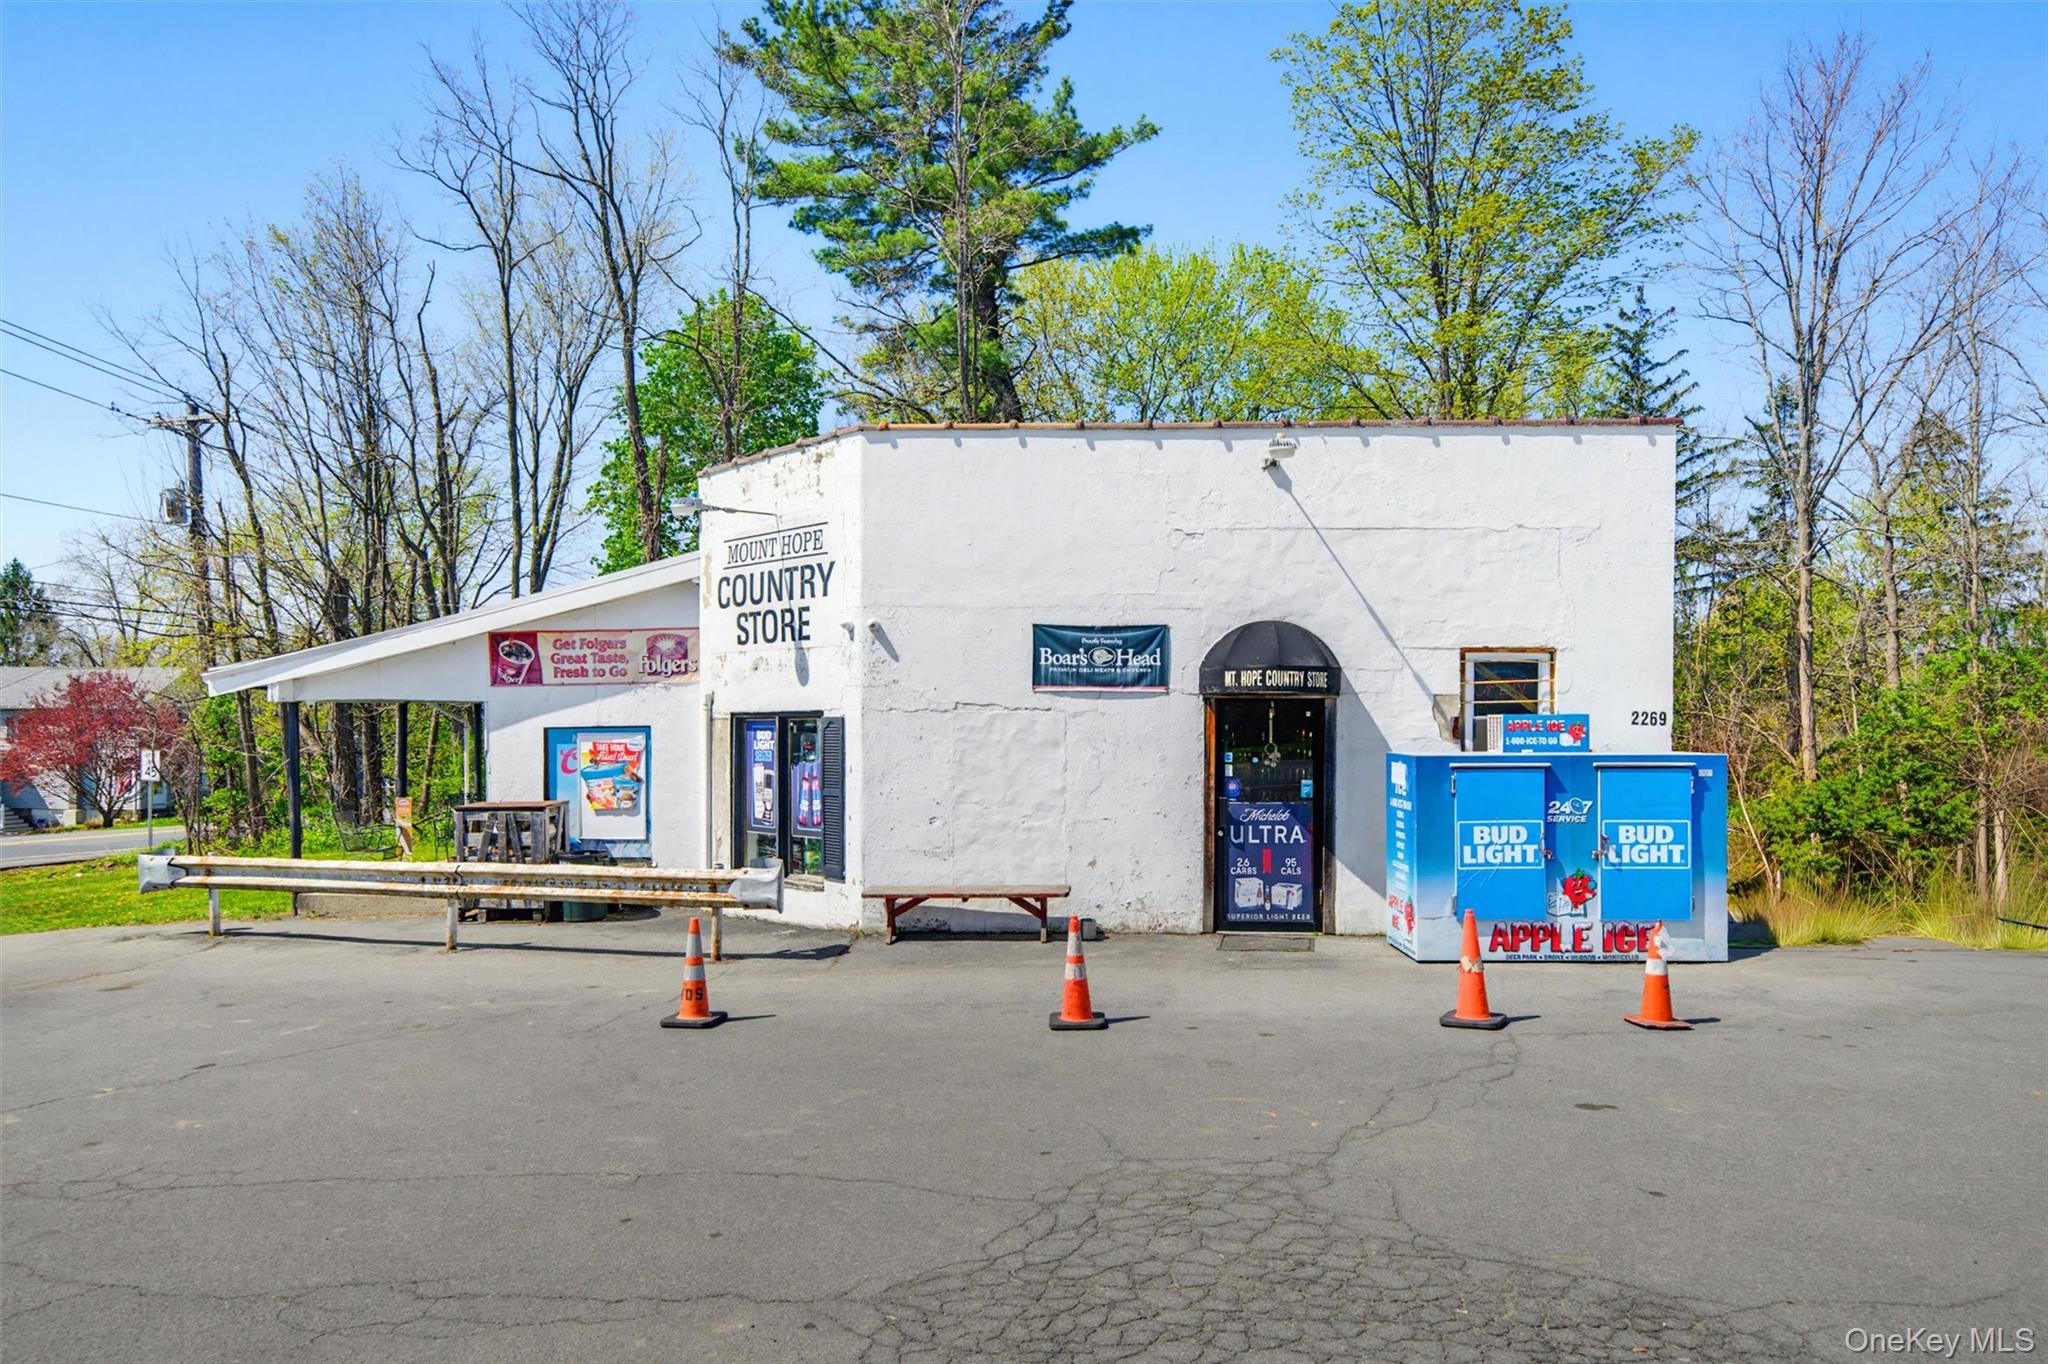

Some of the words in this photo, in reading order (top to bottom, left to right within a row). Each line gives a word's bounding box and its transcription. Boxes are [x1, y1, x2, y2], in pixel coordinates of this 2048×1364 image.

[727, 537, 778, 565] MOUNT
[781, 529, 824, 556] HOPE
[718, 560, 836, 609] COUNTRY
[736, 606, 811, 646] STORE
[552, 638, 576, 651] Get
[579, 637, 627, 652] Folgers
[550, 653, 588, 665] Great
[1039, 647, 1088, 665] Boar's
[1116, 648, 1161, 666] Head
[553, 666, 589, 679] Fresh
[592, 666, 606, 678] to
[609, 666, 629, 678] Go
[1224, 671, 1239, 688] MT.
[1241, 670, 1263, 687] HOPE
[1265, 670, 1305, 687] COUNTRY
[1307, 671, 1328, 688] STORE
[1506, 720, 1544, 732] APPLE
[1546, 720, 1566, 733] ICE
[1631, 710, 1667, 726] 2269
[1240, 808, 1291, 822] Michelob
[1547, 815, 1588, 823] SERVICE
[1230, 825, 1305, 844] ULTRA
[1473, 825, 1528, 844] BUD
[1618, 825, 1674, 844] BUD
[1285, 857, 1297, 867] 95
[1463, 844, 1539, 864] LIGHT
[1608, 844, 1685, 864] LIGHT
[1230, 867, 1257, 875] CARBS
[1281, 867, 1302, 875] CALS
[1489, 921, 1593, 954] APPLE
